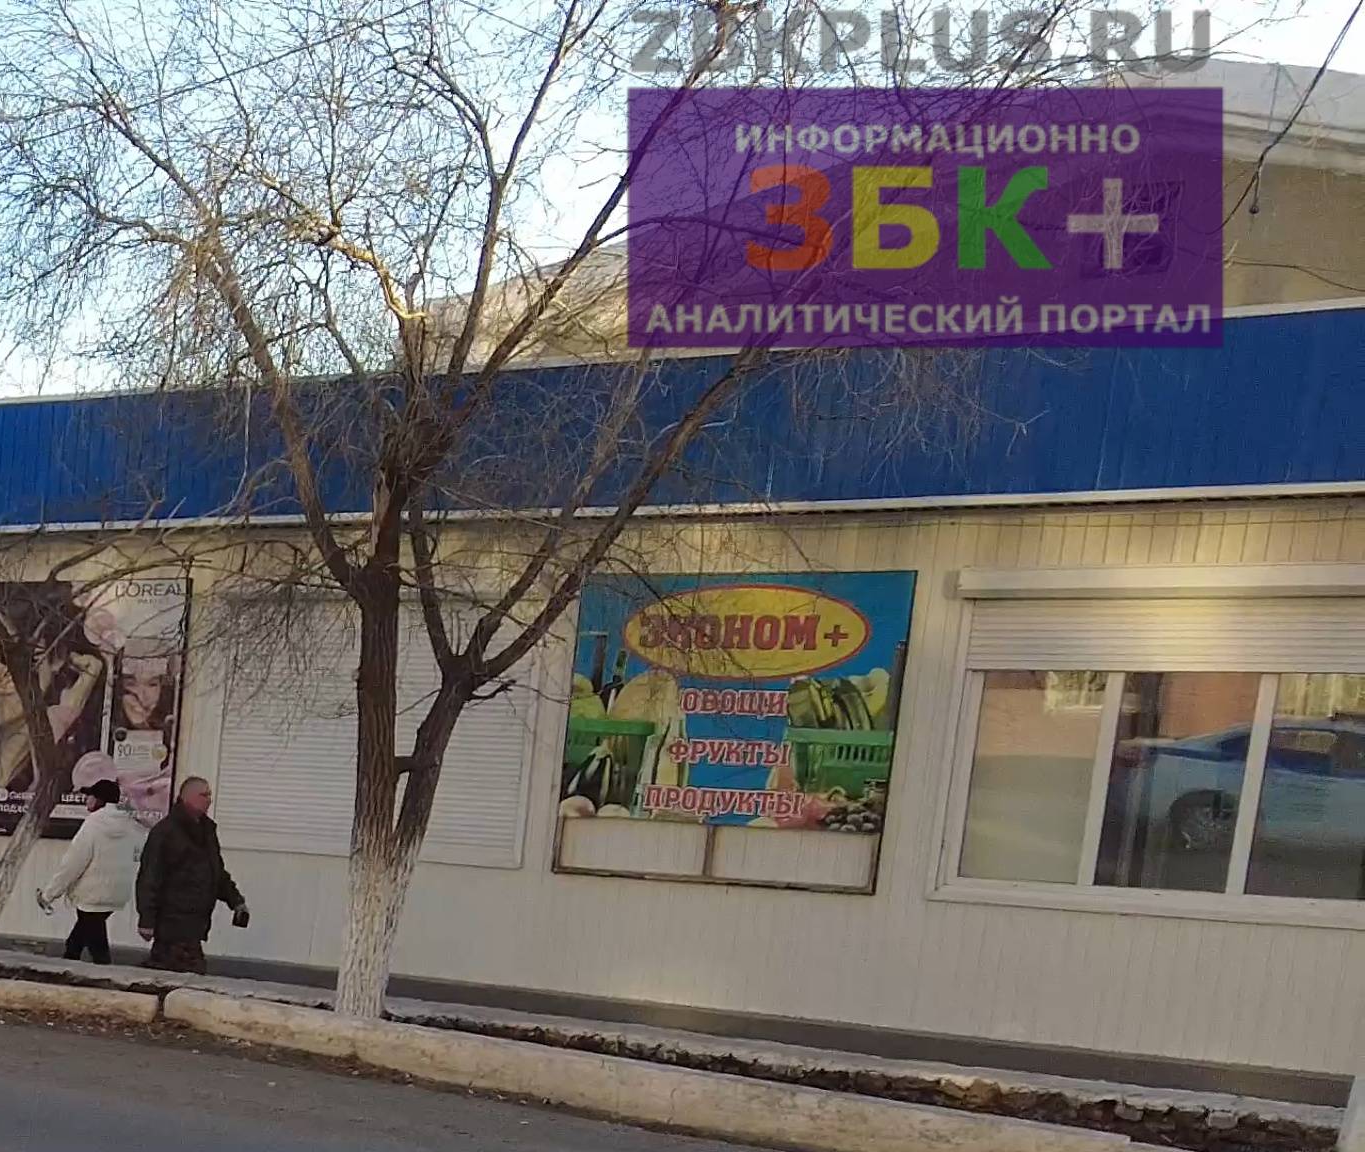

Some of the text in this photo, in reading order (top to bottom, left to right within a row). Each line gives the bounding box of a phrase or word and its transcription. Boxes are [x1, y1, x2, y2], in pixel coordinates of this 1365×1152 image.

[680, 688, 789, 720] ОВОЩИ
[667, 738, 794, 768] ФРУКТЫ
[643, 784, 806, 818] ПРОДУКТЫ
